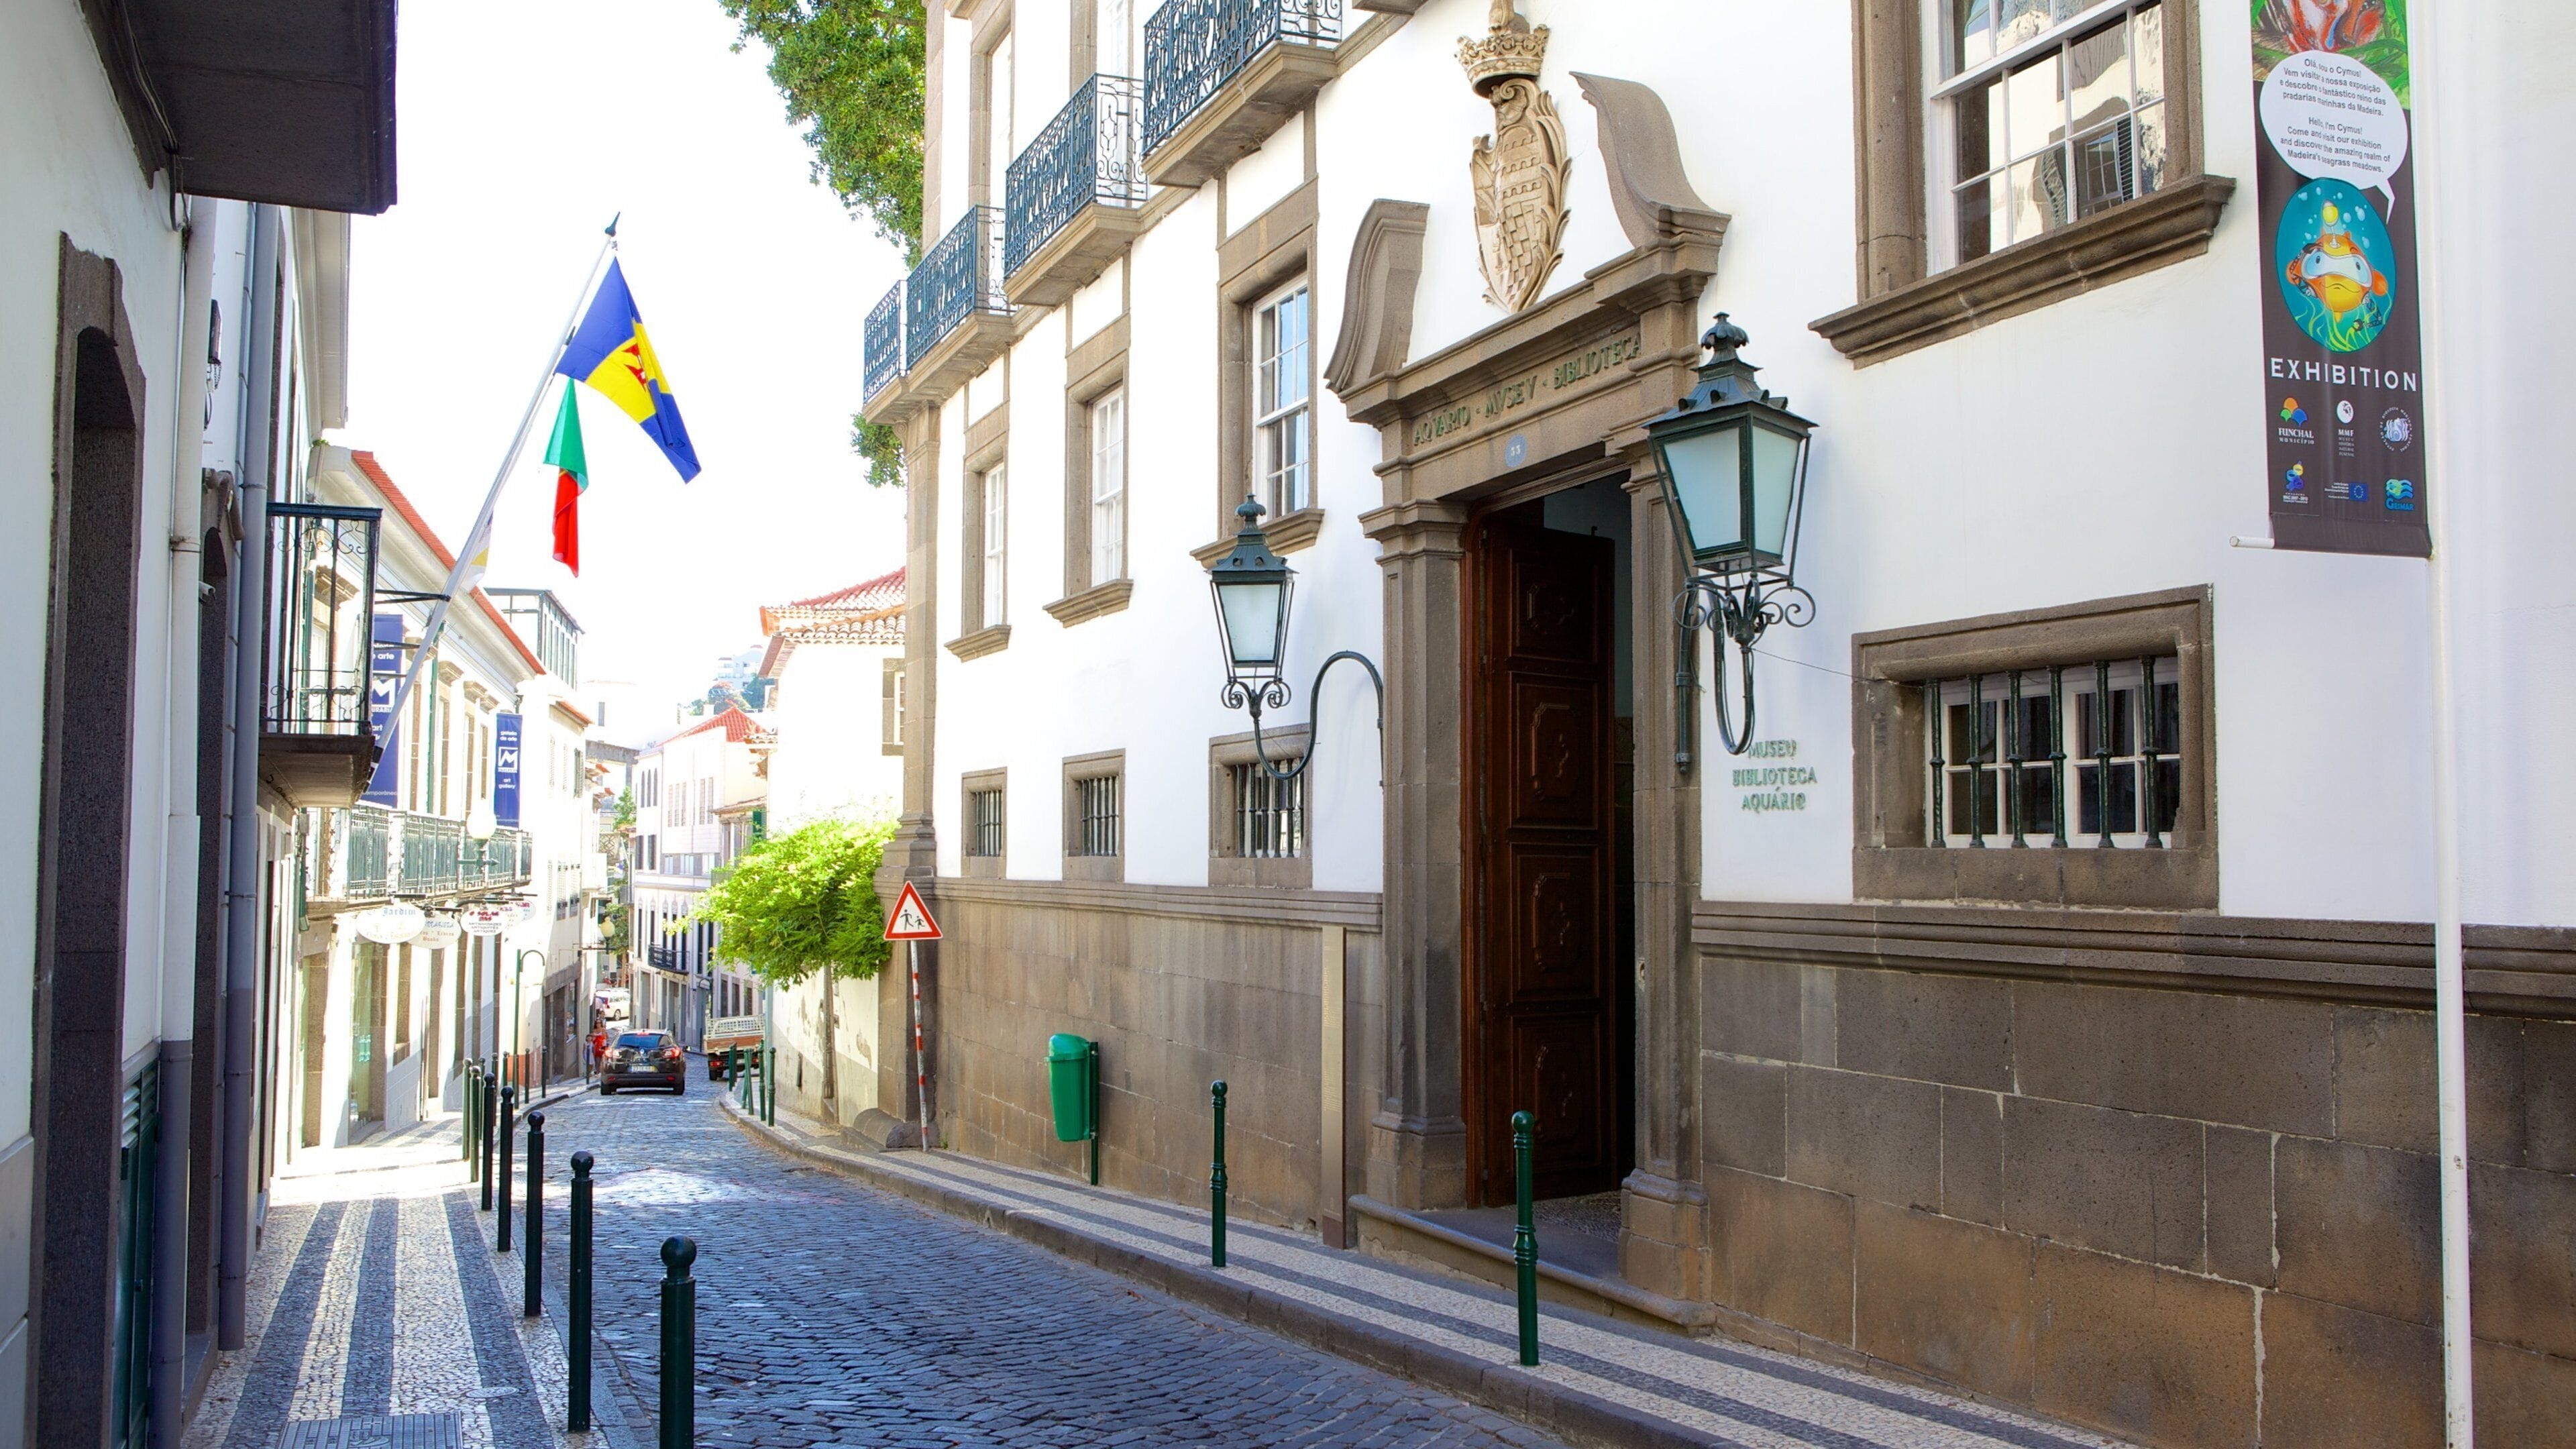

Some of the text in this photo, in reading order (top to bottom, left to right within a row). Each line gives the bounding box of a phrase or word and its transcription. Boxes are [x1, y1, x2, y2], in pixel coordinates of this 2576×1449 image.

[2283, 67, 2298, 77] Vem
[2300, 70, 2320, 80] visitar
[2325, 78, 2347, 86] nossa
[2349, 80, 2381, 93] exposição
[2304, 58, 2318, 69] Olá,
[2336, 66, 2361, 78] Cymus!
[2283, 91, 2384, 116] pradarias marinhas da Madeira.
[2284, 79, 2318, 91] descobre
[2322, 87, 2356, 99] fantástico
[2357, 94, 2372, 103] reino
[2373, 97, 2386, 105] das
[2287, 126, 2381, 150] Come and visit our exhibition
[2325, 122, 2335, 131] I'm
[2337, 123, 2363, 134] Cymus!
[2280, 138, 2391, 162] and discover the amazing realm of
[2287, 149, 2384, 173] Madeira's seagrass meadows.
[1554, 331, 1642, 390] BIBLIOTECA
[2270, 357, 2417, 392] EXHIBITION
[2278, 427, 2314, 438] FUNCHAL
[377, 652, 394, 660] arte
[1748, 739, 1797, 759] MUSEU
[1732, 766, 1818, 786] BIBLIOTECA
[1741, 786, 1806, 813] AQUÁRIO
